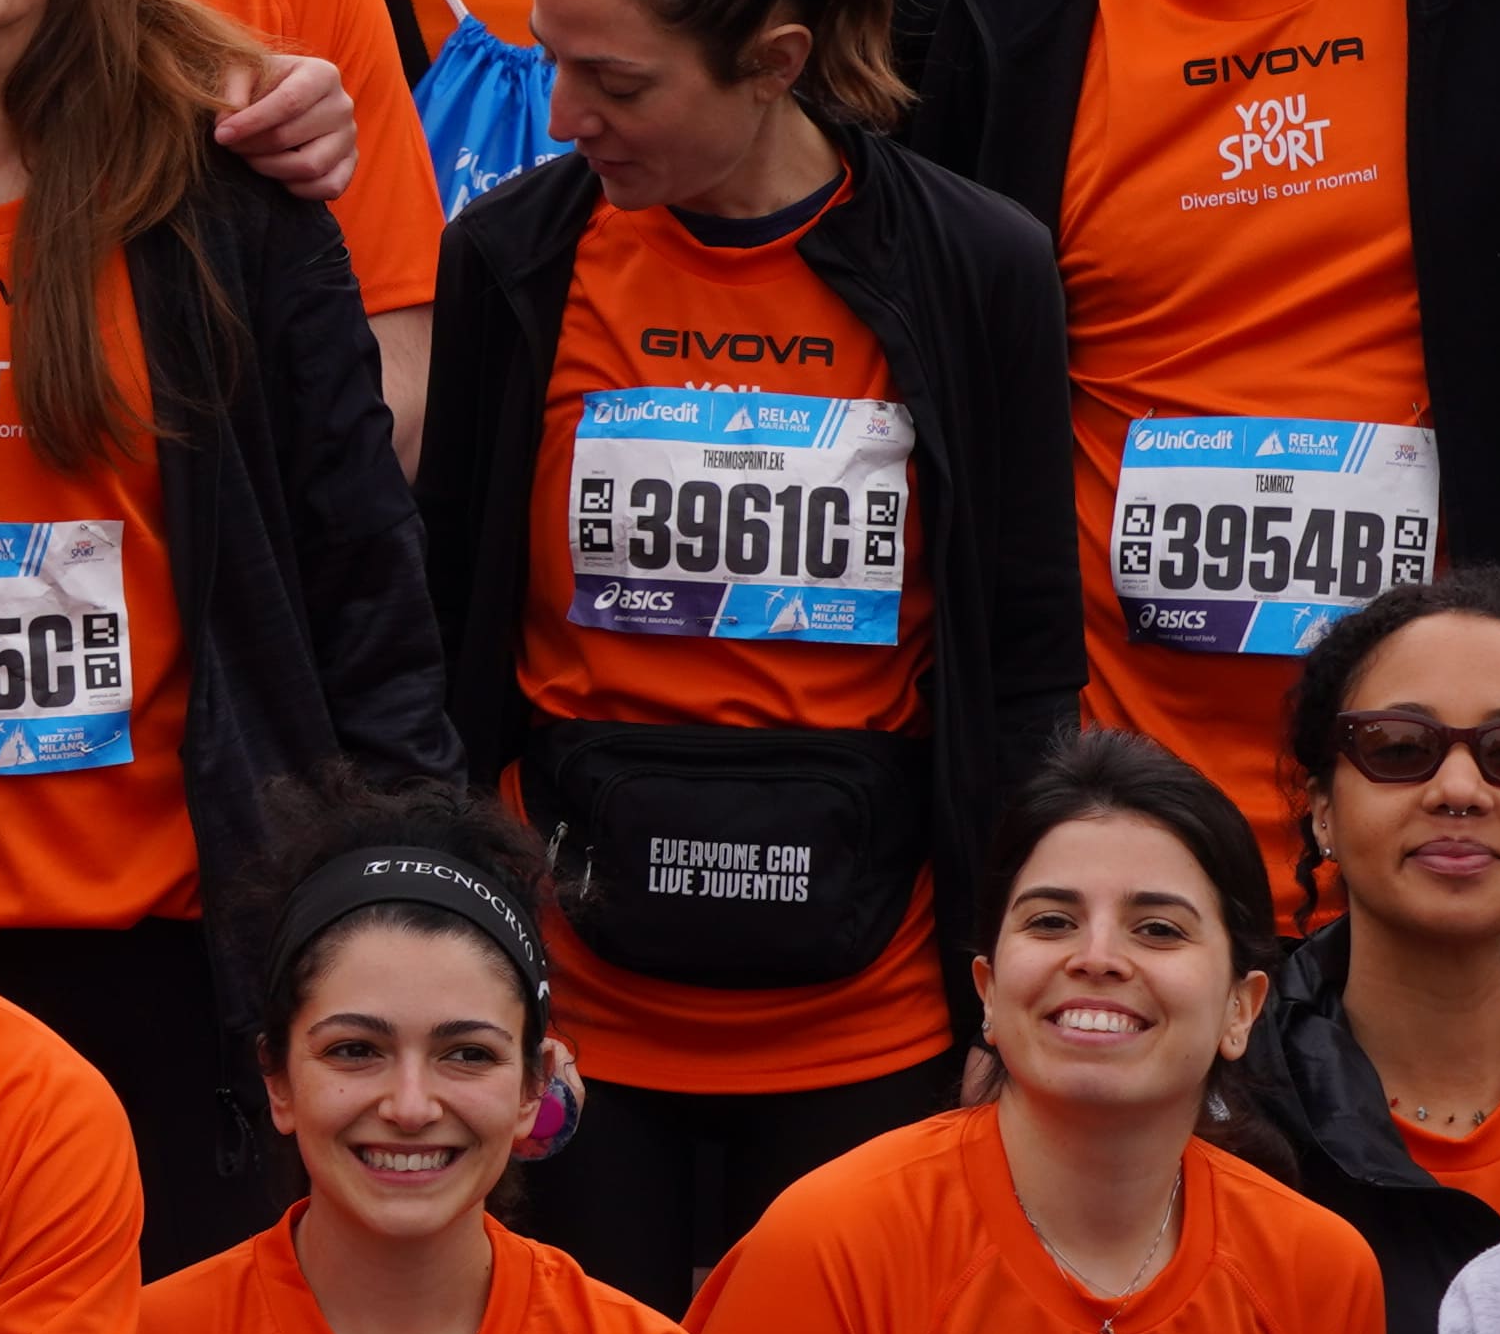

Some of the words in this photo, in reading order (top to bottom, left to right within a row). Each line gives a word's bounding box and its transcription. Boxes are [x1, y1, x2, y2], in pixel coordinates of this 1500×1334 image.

[1183, 37, 1364, 86] GIVOVA
[1235, 93, 1307, 135] YOU
[1218, 119, 1331, 181] SPORT
[1180, 185, 1258, 211] Diversity
[1263, 183, 1278, 199] is
[1282, 178, 1311, 197] our
[1315, 164, 1378, 190] normal
[640, 328, 834, 366] GIVOVA
[614, 399, 699, 423] UniCredit
[758, 406, 811, 424] RELAY
[758, 421, 811, 433] MARATHON
[1155, 429, 1234, 450] UniCredit
[1288, 433, 1339, 448] RELAY
[1288, 446, 1339, 457] MARATHON
[703, 449, 785, 471] THERMOSPRINT.EXE
[1255, 474, 1295, 495] TEAMRIZZ
[628, 478, 850, 579] 3961C
[1158, 503, 1385, 598] 3954B
[619, 590, 675, 611] asics
[1156, 610, 1207, 630] asics
[650, 836, 760, 872] EVERYONE
[765, 844, 811, 873] CAN
[648, 865, 694, 896] LIVE
[699, 869, 809, 903] JUVENTUS
